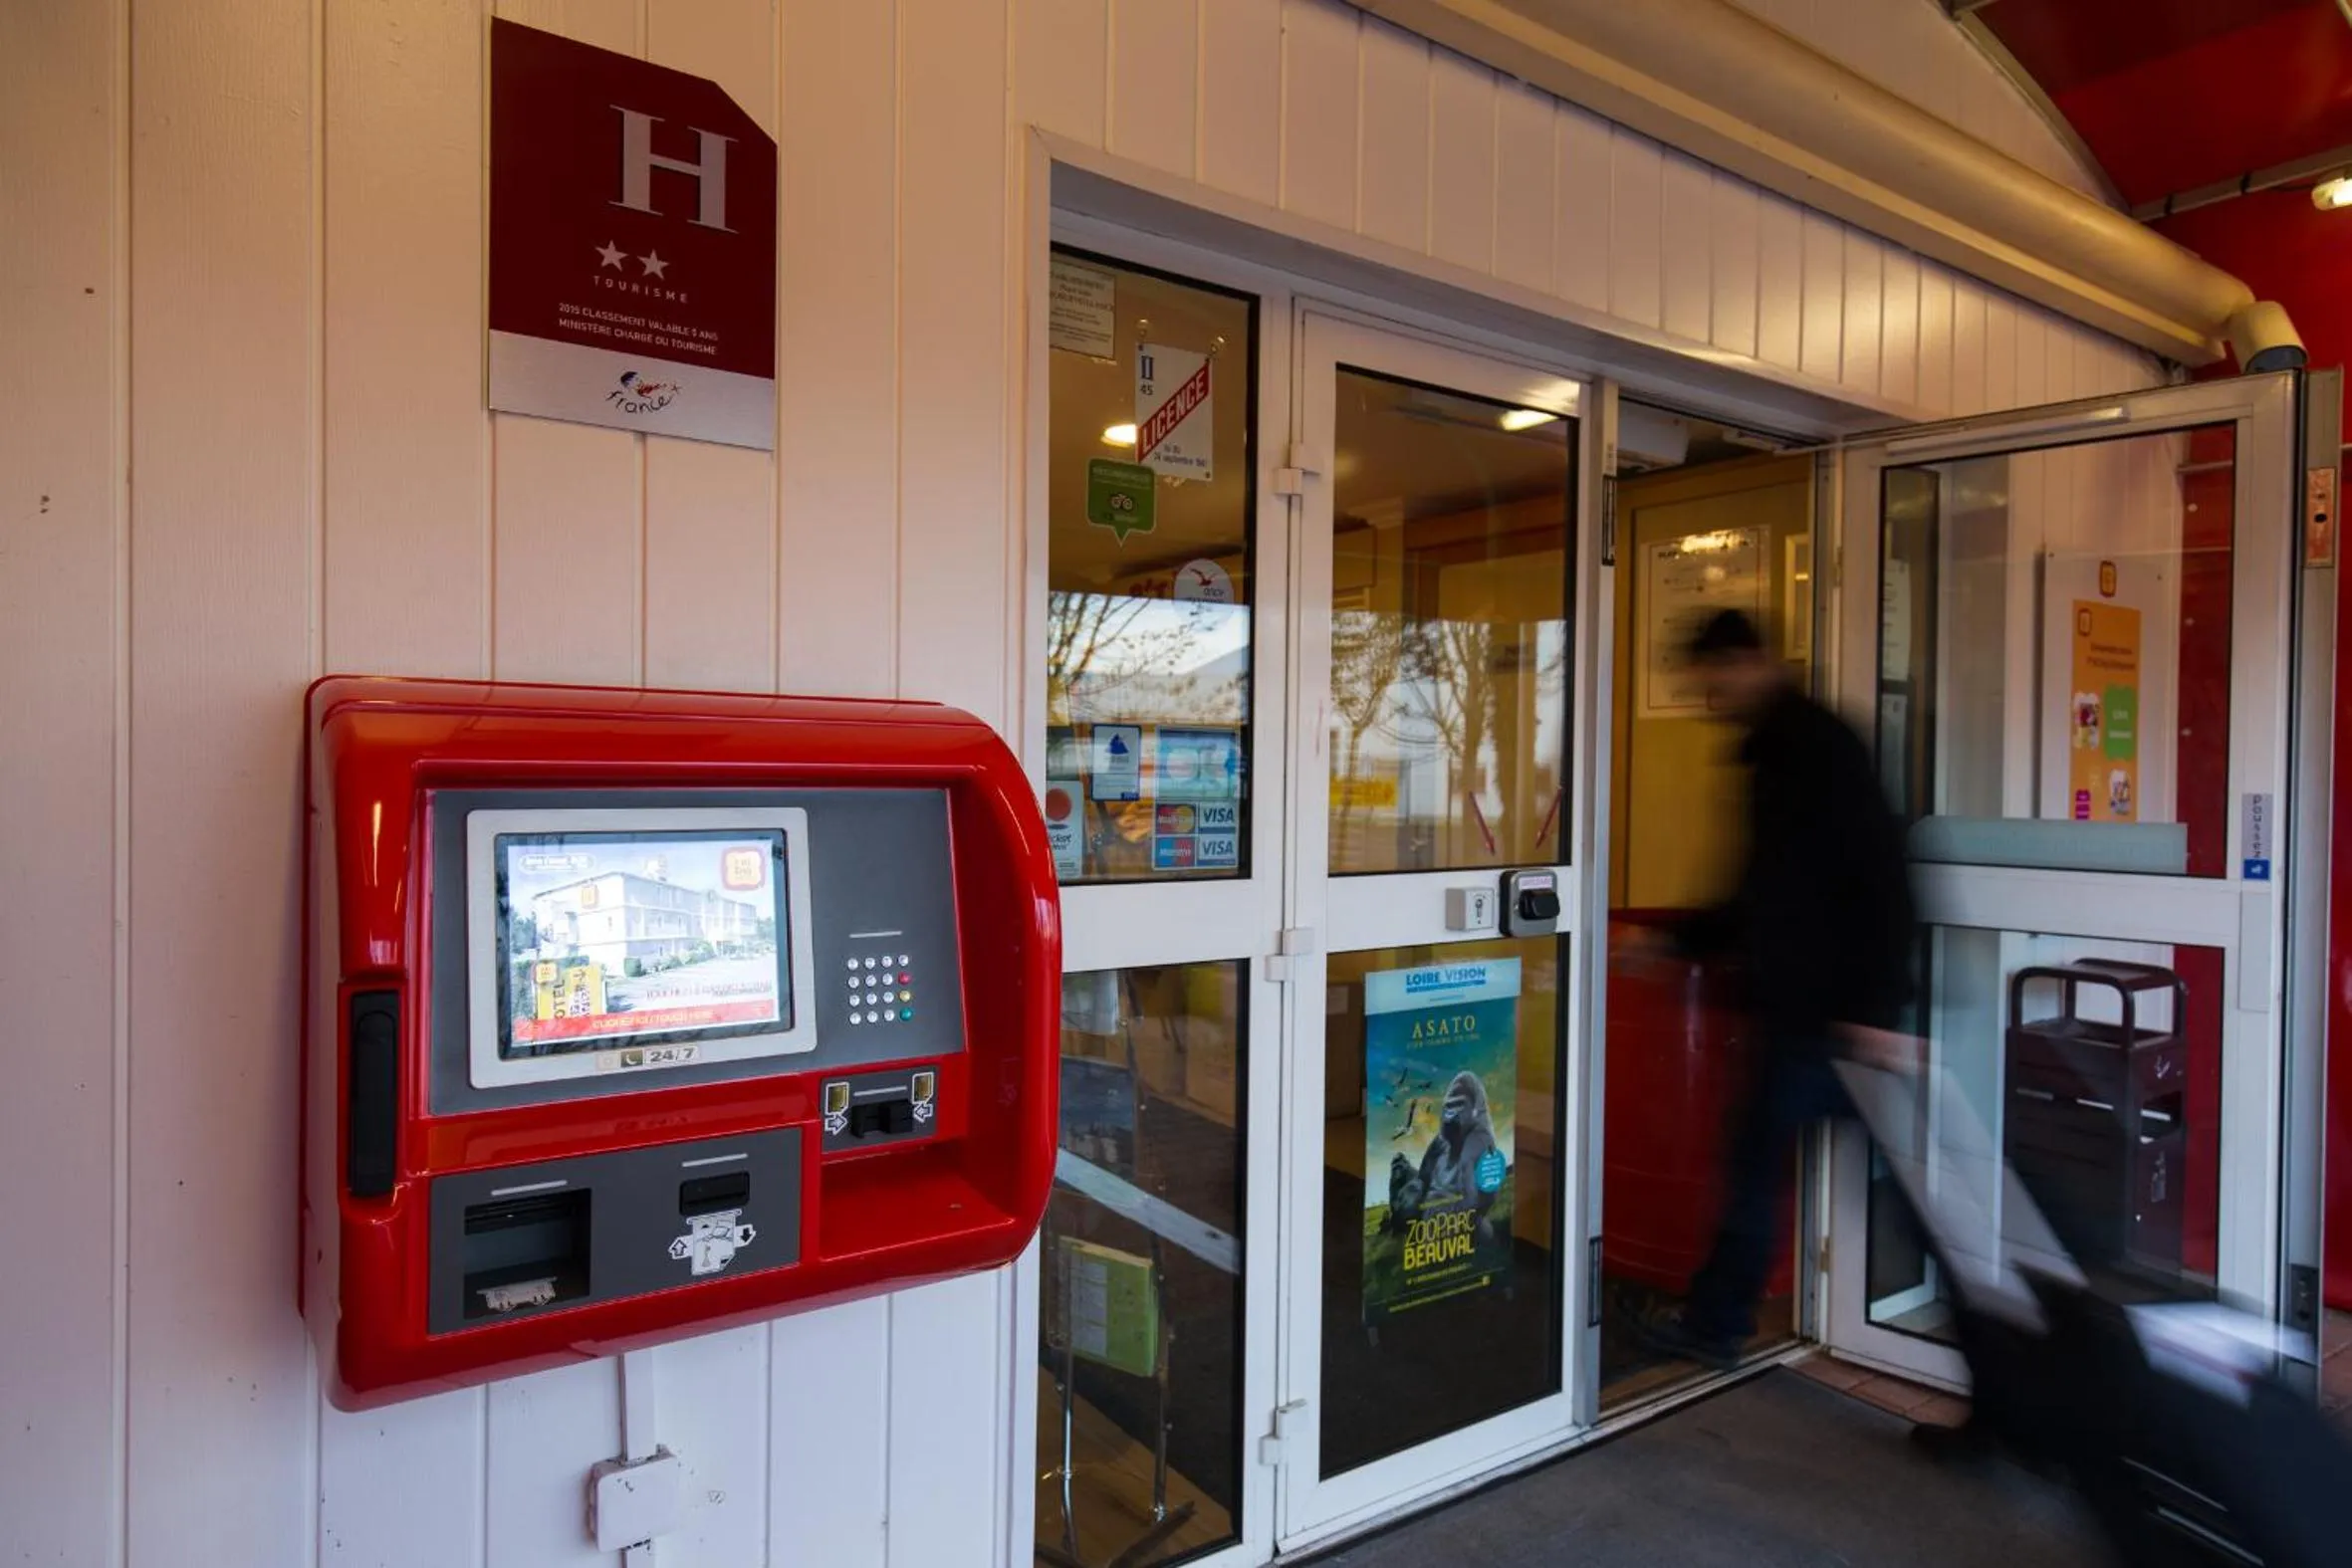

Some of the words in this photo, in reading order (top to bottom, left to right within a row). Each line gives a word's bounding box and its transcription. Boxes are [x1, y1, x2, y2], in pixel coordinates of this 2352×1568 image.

[607, 104, 738, 233] H
[593, 276, 688, 303] TOURISME
[583, 307, 646, 328] CLASSEMENT
[648, 320, 689, 336] VALABLE
[699, 331, 719, 341] ANS
[655, 336, 669, 346] DU
[671, 337, 718, 355] TOURISME
[1140, 382, 1154, 396] 45
[1142, 369, 1207, 454] LICENCE
[1203, 807, 1236, 823] VISA
[1203, 840, 1235, 856] VISA
[1406, 972, 1441, 986] LOIRE
[1445, 967, 1487, 981] VISION
[553, 979, 566, 1020] OTEL
[1412, 1014, 1476, 1039] ASATO
[649, 1047, 695, 1062] 24/7
[1404, 1209, 1477, 1246] ZOOPARC
[1403, 1233, 1476, 1270] BEAUVAL
